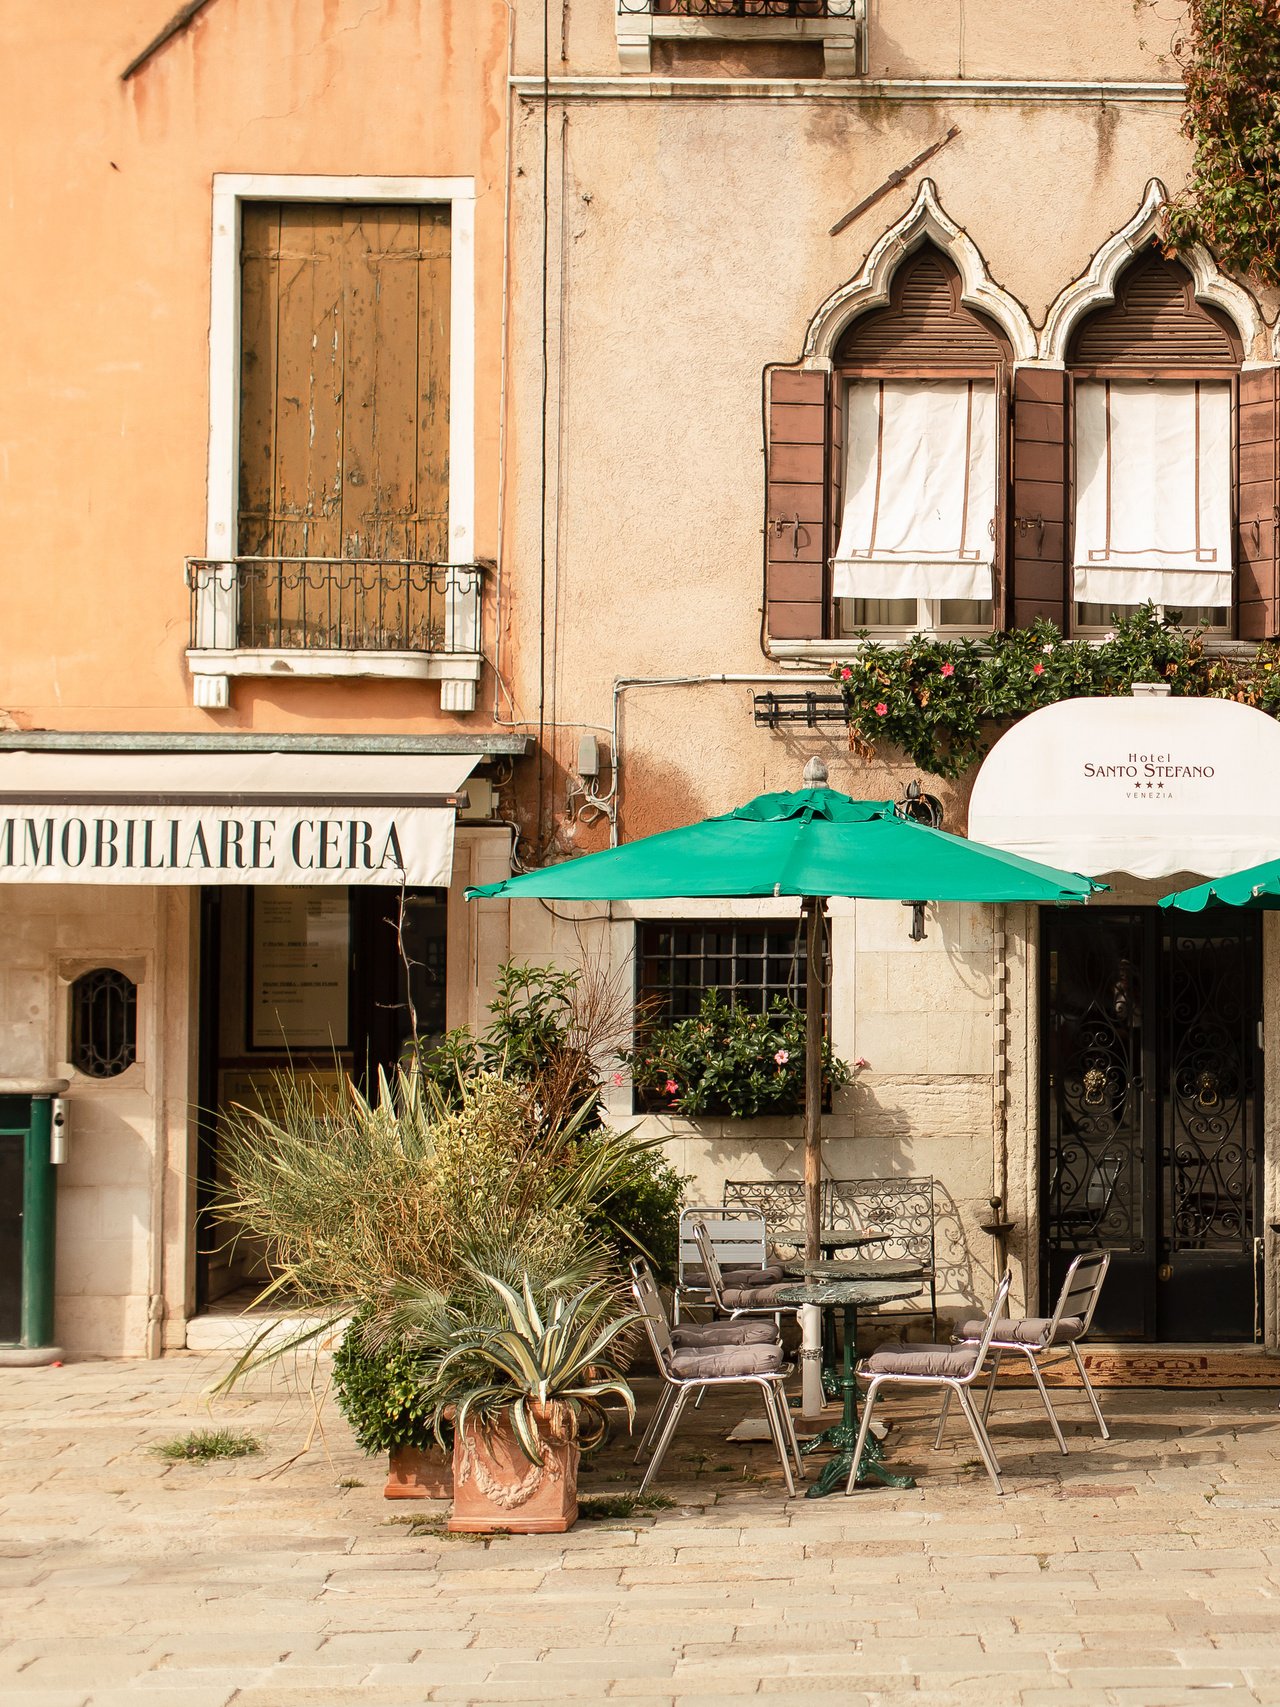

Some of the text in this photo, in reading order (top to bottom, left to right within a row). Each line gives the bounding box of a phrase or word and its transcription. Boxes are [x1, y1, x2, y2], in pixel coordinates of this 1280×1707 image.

[1128, 753, 1171, 763] Hotel
[1083, 762, 1215, 778] SANTO STEFANO
[291, 819, 407, 870] CERA
